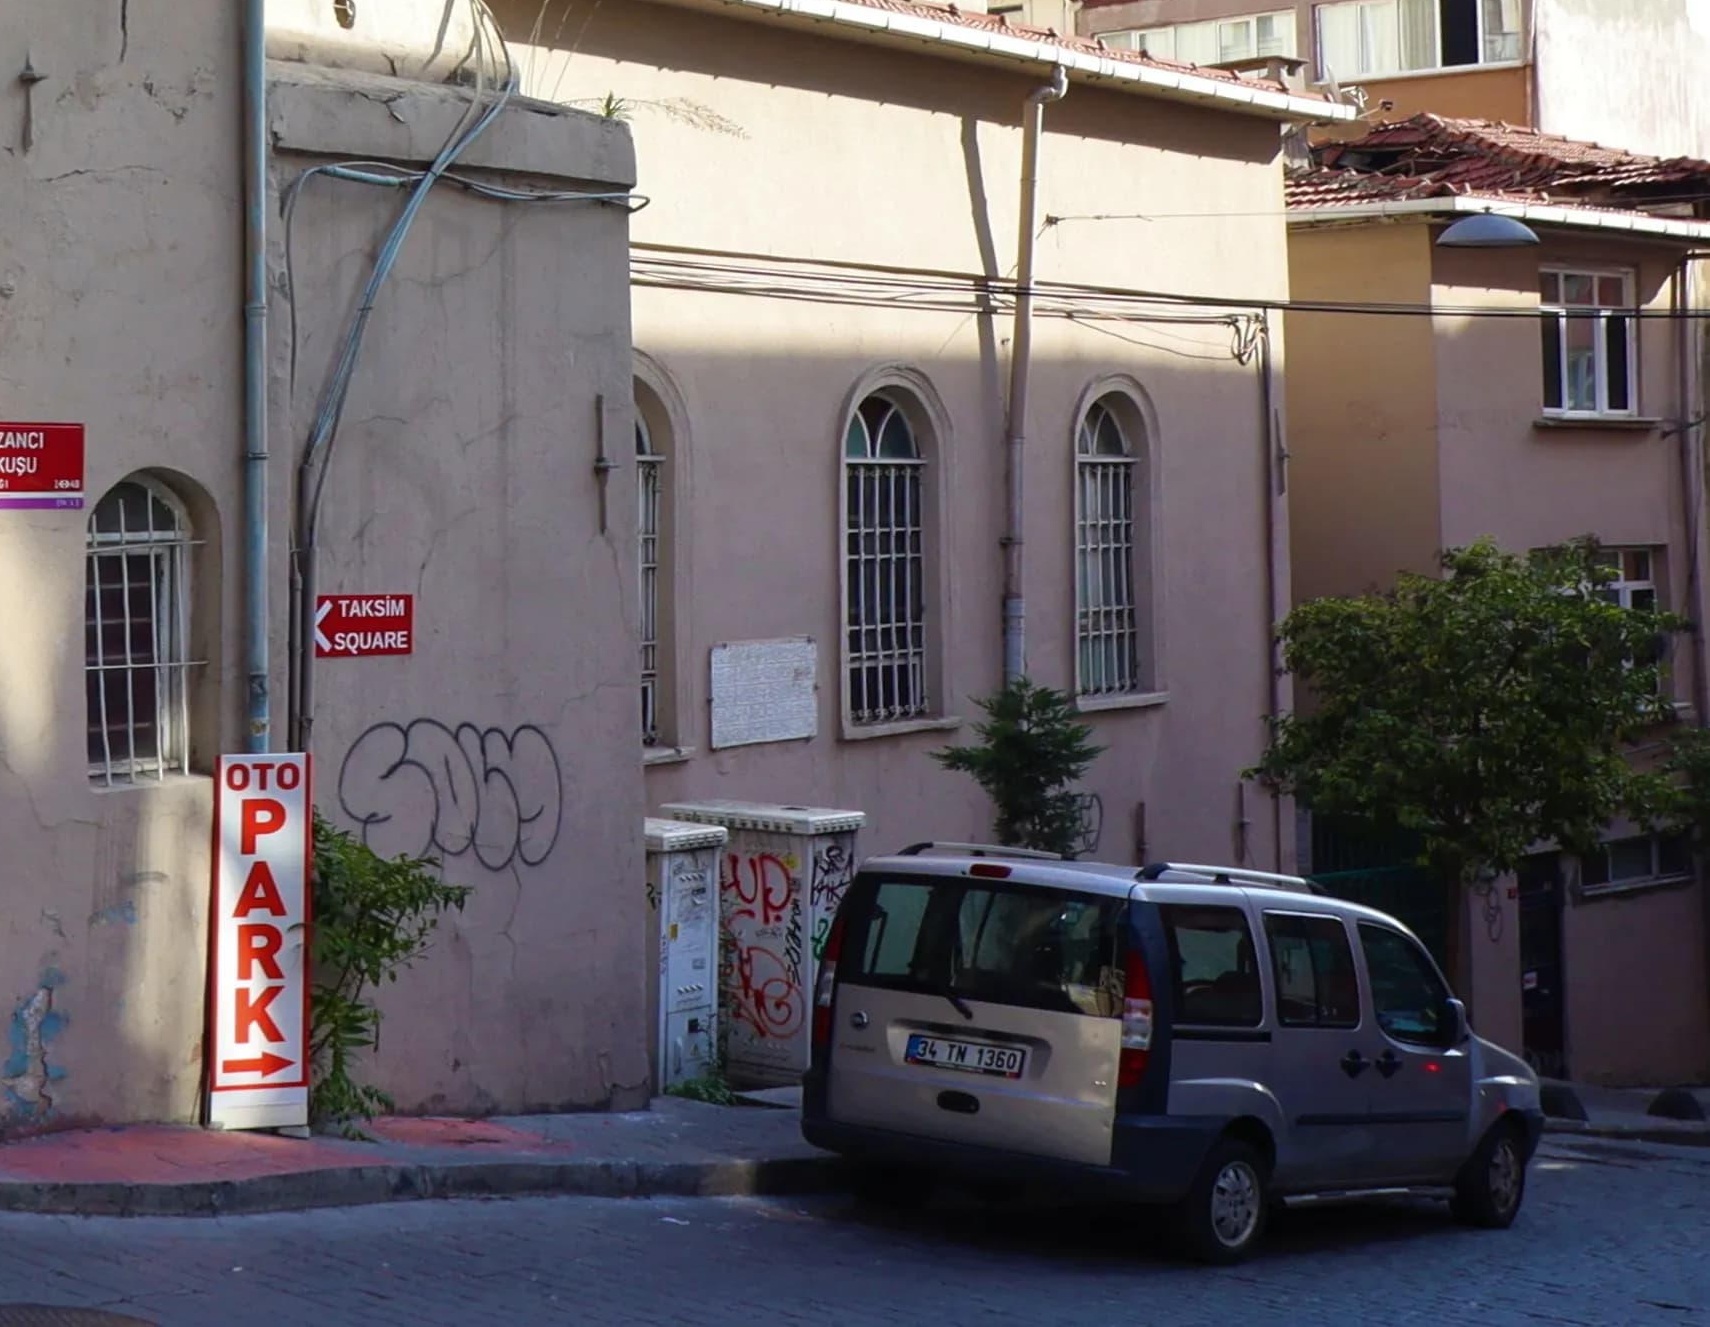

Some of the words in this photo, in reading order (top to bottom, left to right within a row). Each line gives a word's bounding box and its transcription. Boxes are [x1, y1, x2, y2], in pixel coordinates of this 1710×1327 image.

[338, 595, 405, 617] TAKSİM
[334, 631, 408, 654] SQUARE
[226, 763, 300, 791] OTO
[233, 798, 287, 1044] PARK
[917, 1040, 937, 1058] 34
[946, 1044, 968, 1063] TN
[976, 1049, 1017, 1070] 1360
